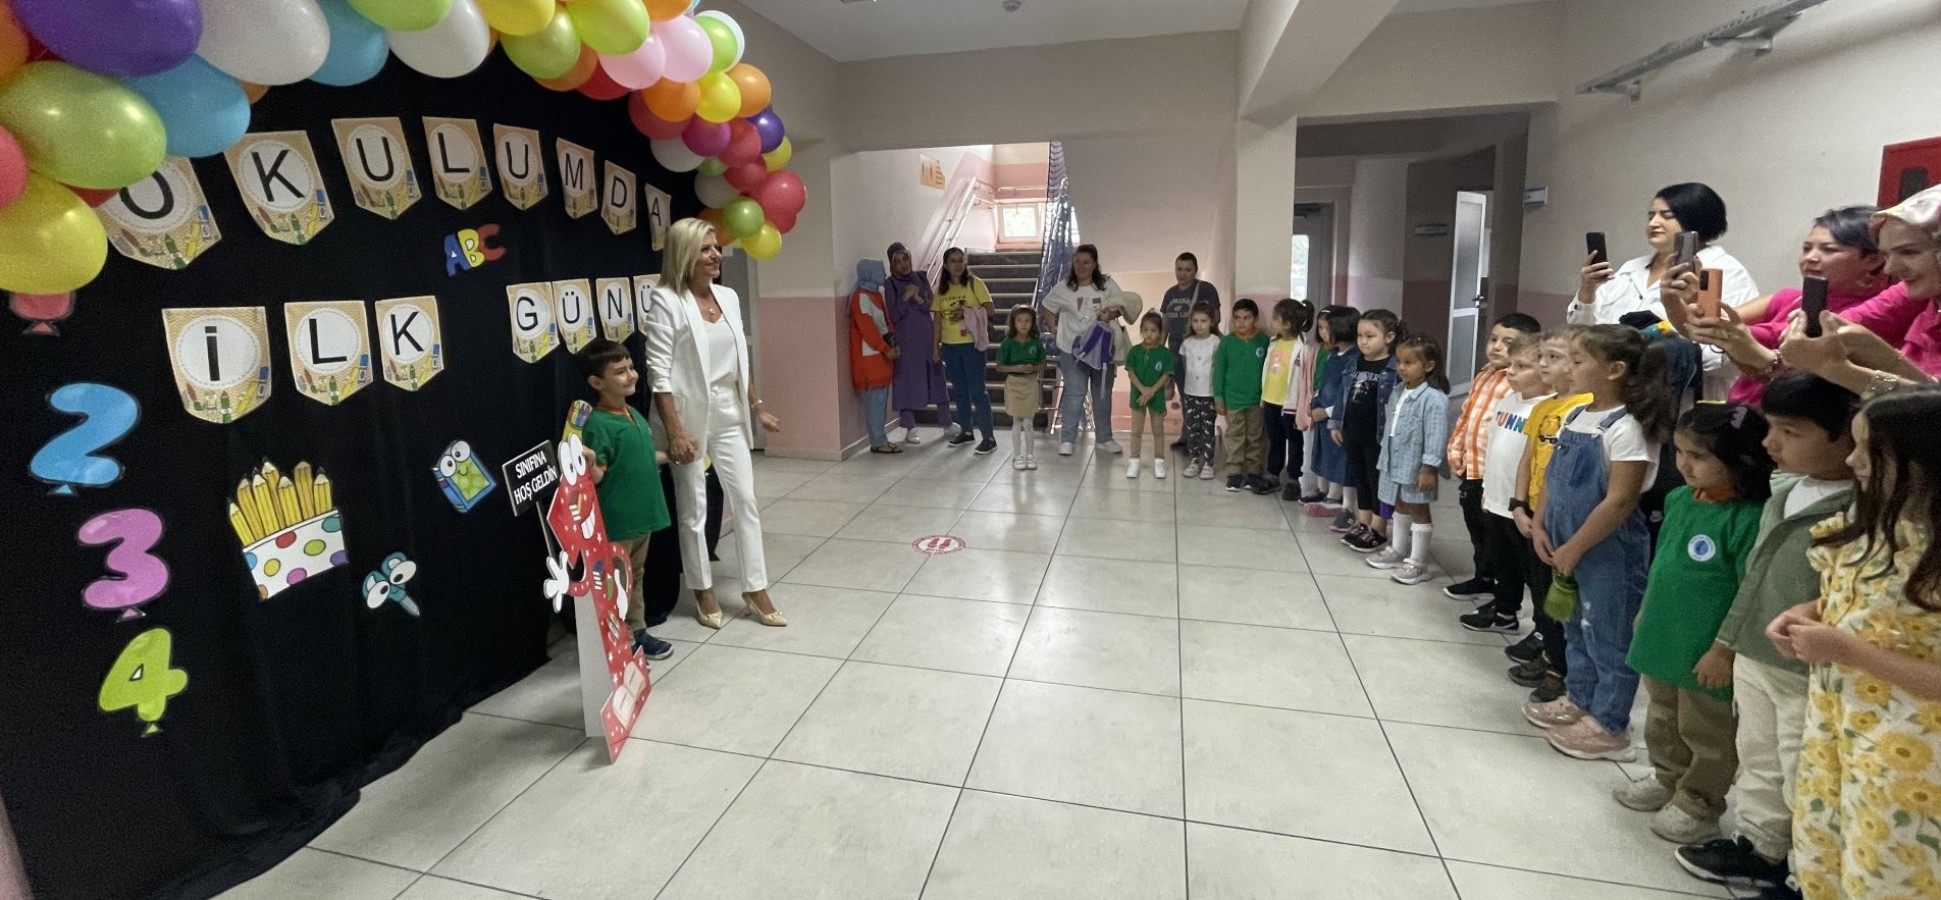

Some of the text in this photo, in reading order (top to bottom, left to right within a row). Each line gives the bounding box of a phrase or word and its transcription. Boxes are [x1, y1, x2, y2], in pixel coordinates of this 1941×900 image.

[119, 131, 661, 226] OKULUMDA
[444, 223, 507, 277] ABC
[204, 311, 425, 382] İLK
[29, 382, 140, 486] 2
[515, 450, 547, 479] SINIFINA
[513, 465, 558, 505] HOŞ GELDİN
[78, 508, 170, 609] 3
[98, 628, 189, 722] 4
